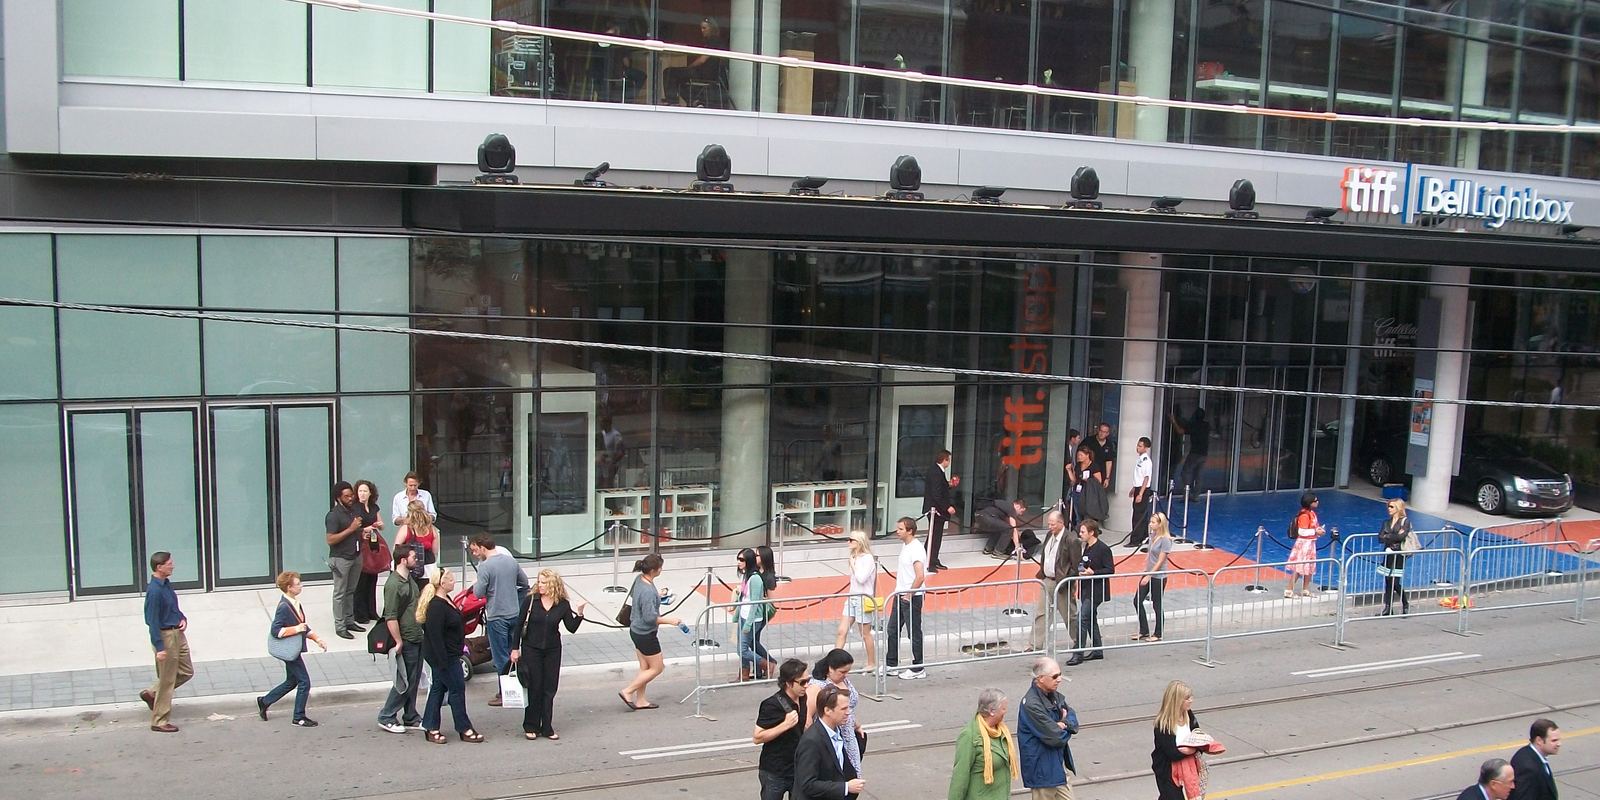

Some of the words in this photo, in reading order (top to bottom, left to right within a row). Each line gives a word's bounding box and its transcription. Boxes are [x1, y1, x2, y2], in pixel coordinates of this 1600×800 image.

[1341, 167, 1400, 215] tiff.
[1421, 176, 1471, 217] Bell
[1472, 181, 1576, 229] Lightbox
[1001, 389, 1046, 470] tiff.
